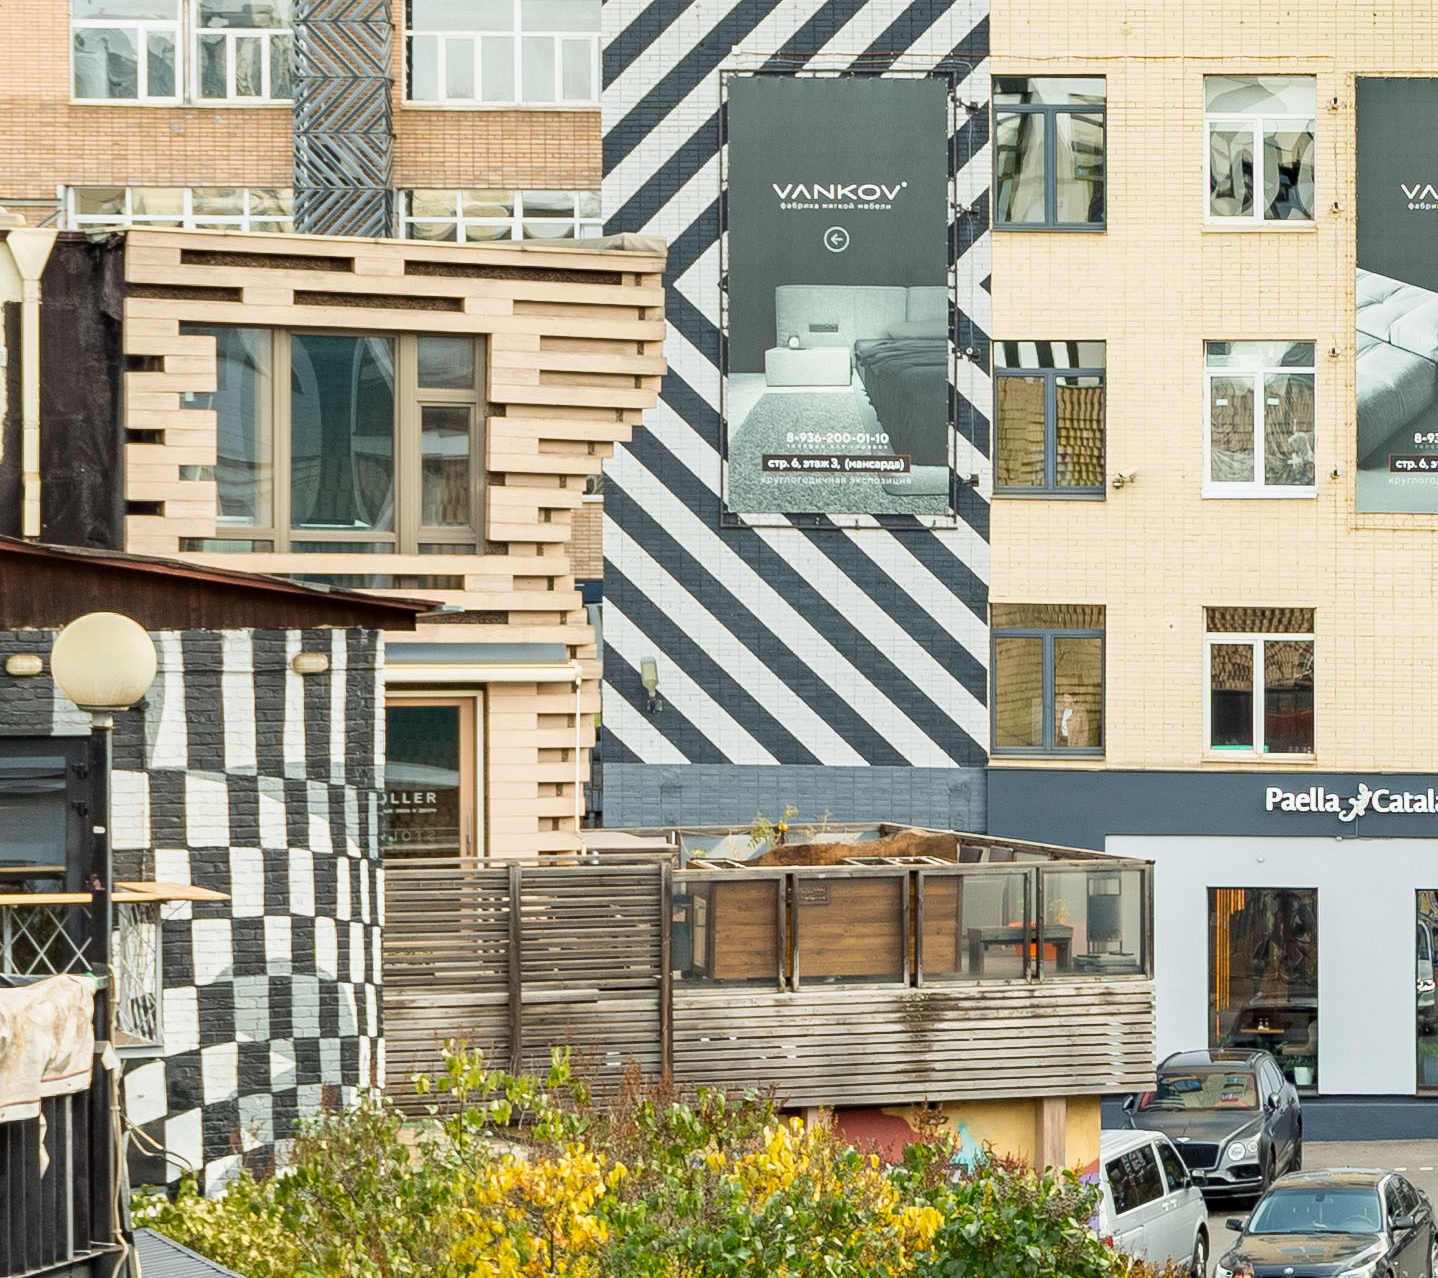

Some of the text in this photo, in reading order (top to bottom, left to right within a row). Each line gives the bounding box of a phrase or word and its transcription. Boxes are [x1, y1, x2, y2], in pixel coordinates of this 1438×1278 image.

[772, 183, 901, 201] VANKOV
[786, 432, 890, 444] 8-936-200-01-10
[768, 459, 790, 470] стр.
[803, 459, 829, 469] этаж
[1395, 459, 1417, 470] стр.
[1265, 786, 1341, 812] Paella
